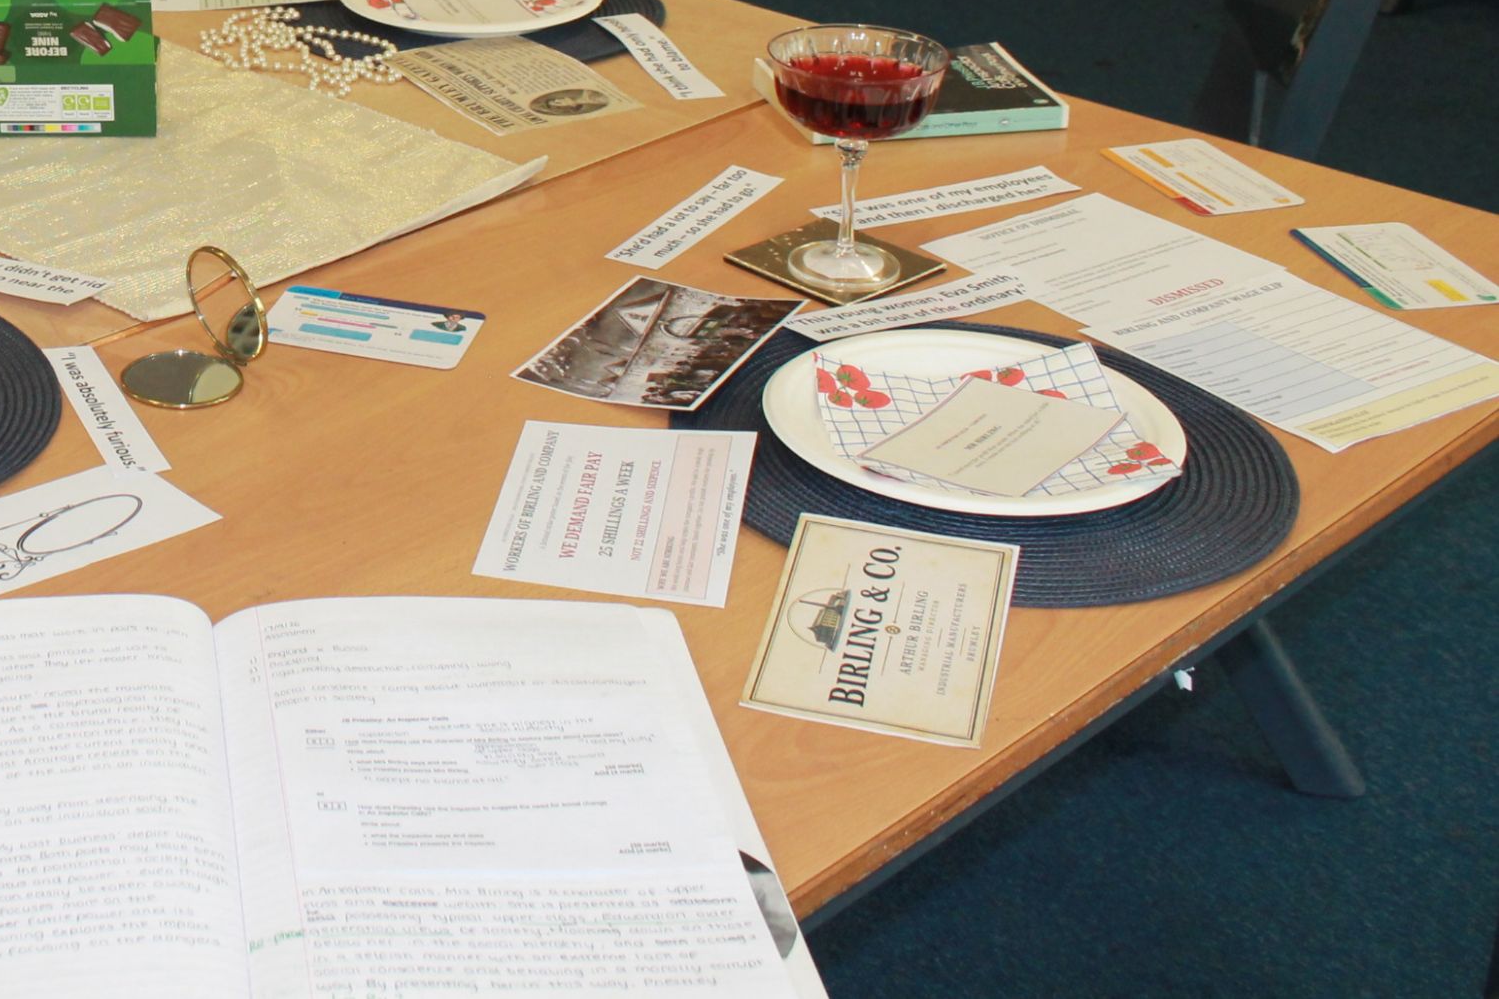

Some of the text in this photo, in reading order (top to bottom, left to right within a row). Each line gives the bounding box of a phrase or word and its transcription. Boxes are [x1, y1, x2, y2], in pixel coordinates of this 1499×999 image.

[24, 47, 68, 57] BEFORE
[31, 36, 60, 47] NINE
[636, 47, 658, 63] had
[712, 179, 732, 192] far
[728, 169, 748, 183] too
[866, 172, 1054, 211] was one of my employees
[668, 210, 689, 222] lot
[682, 203, 699, 213] to
[695, 194, 716, 206] say
[856, 213, 886, 226] and
[887, 207, 926, 221] then
[935, 190, 1015, 211] discharged
[643, 225, 668, 241] had
[653, 237, 683, 258] much
[685, 224, 701, 235] so
[696, 215, 717, 227] she
[708, 201, 733, 216] had
[727, 195, 744, 205] to
[664, 220, 676, 228] a
[3, 262, 52, 281] didn't
[50, 273, 82, 289] get
[81, 277, 107, 290] rid
[5, 278, 44, 292] near
[44, 283, 76, 296] the
[1148, 276, 1225, 306] DISMISSED
[833, 305, 878, 322] young
[881, 295, 943, 313] woman,
[940, 286, 969, 300] Eva
[969, 273, 1020, 292] Smith,
[1111, 280, 1285, 338] BIRLING AND COMPANY WAGE SLIP
[815, 324, 849, 336] was
[850, 322, 861, 331] a
[860, 315, 886, 328] bit
[885, 312, 911, 324] out
[915, 306, 933, 318] of
[931, 302, 958, 316] the
[64, 361, 85, 381] was
[75, 381, 116, 430] absolutely
[646, 459, 662, 491] SIXPENCE
[502, 429, 560, 572] WORKERS OF BIRLING AND COMPANY
[558, 451, 603, 559] WE DEMAND FAIR PAY
[598, 460, 635, 558] 25 SHILLINGS A WEEK
[644, 489, 656, 505] AND
[635, 504, 653, 537] SHILLINGS
[630, 545, 643, 561] NOT
[827, 545, 903, 708] BIRLING & CO.
[899, 589, 930, 677] ARTHUR BIRLING
[918, 599, 940, 672] MANAGING DIRECTOR
[936, 582, 968, 697] INDUSTRIAL MANUFACTURERS
[966, 624, 981, 663] BRUMLEY
